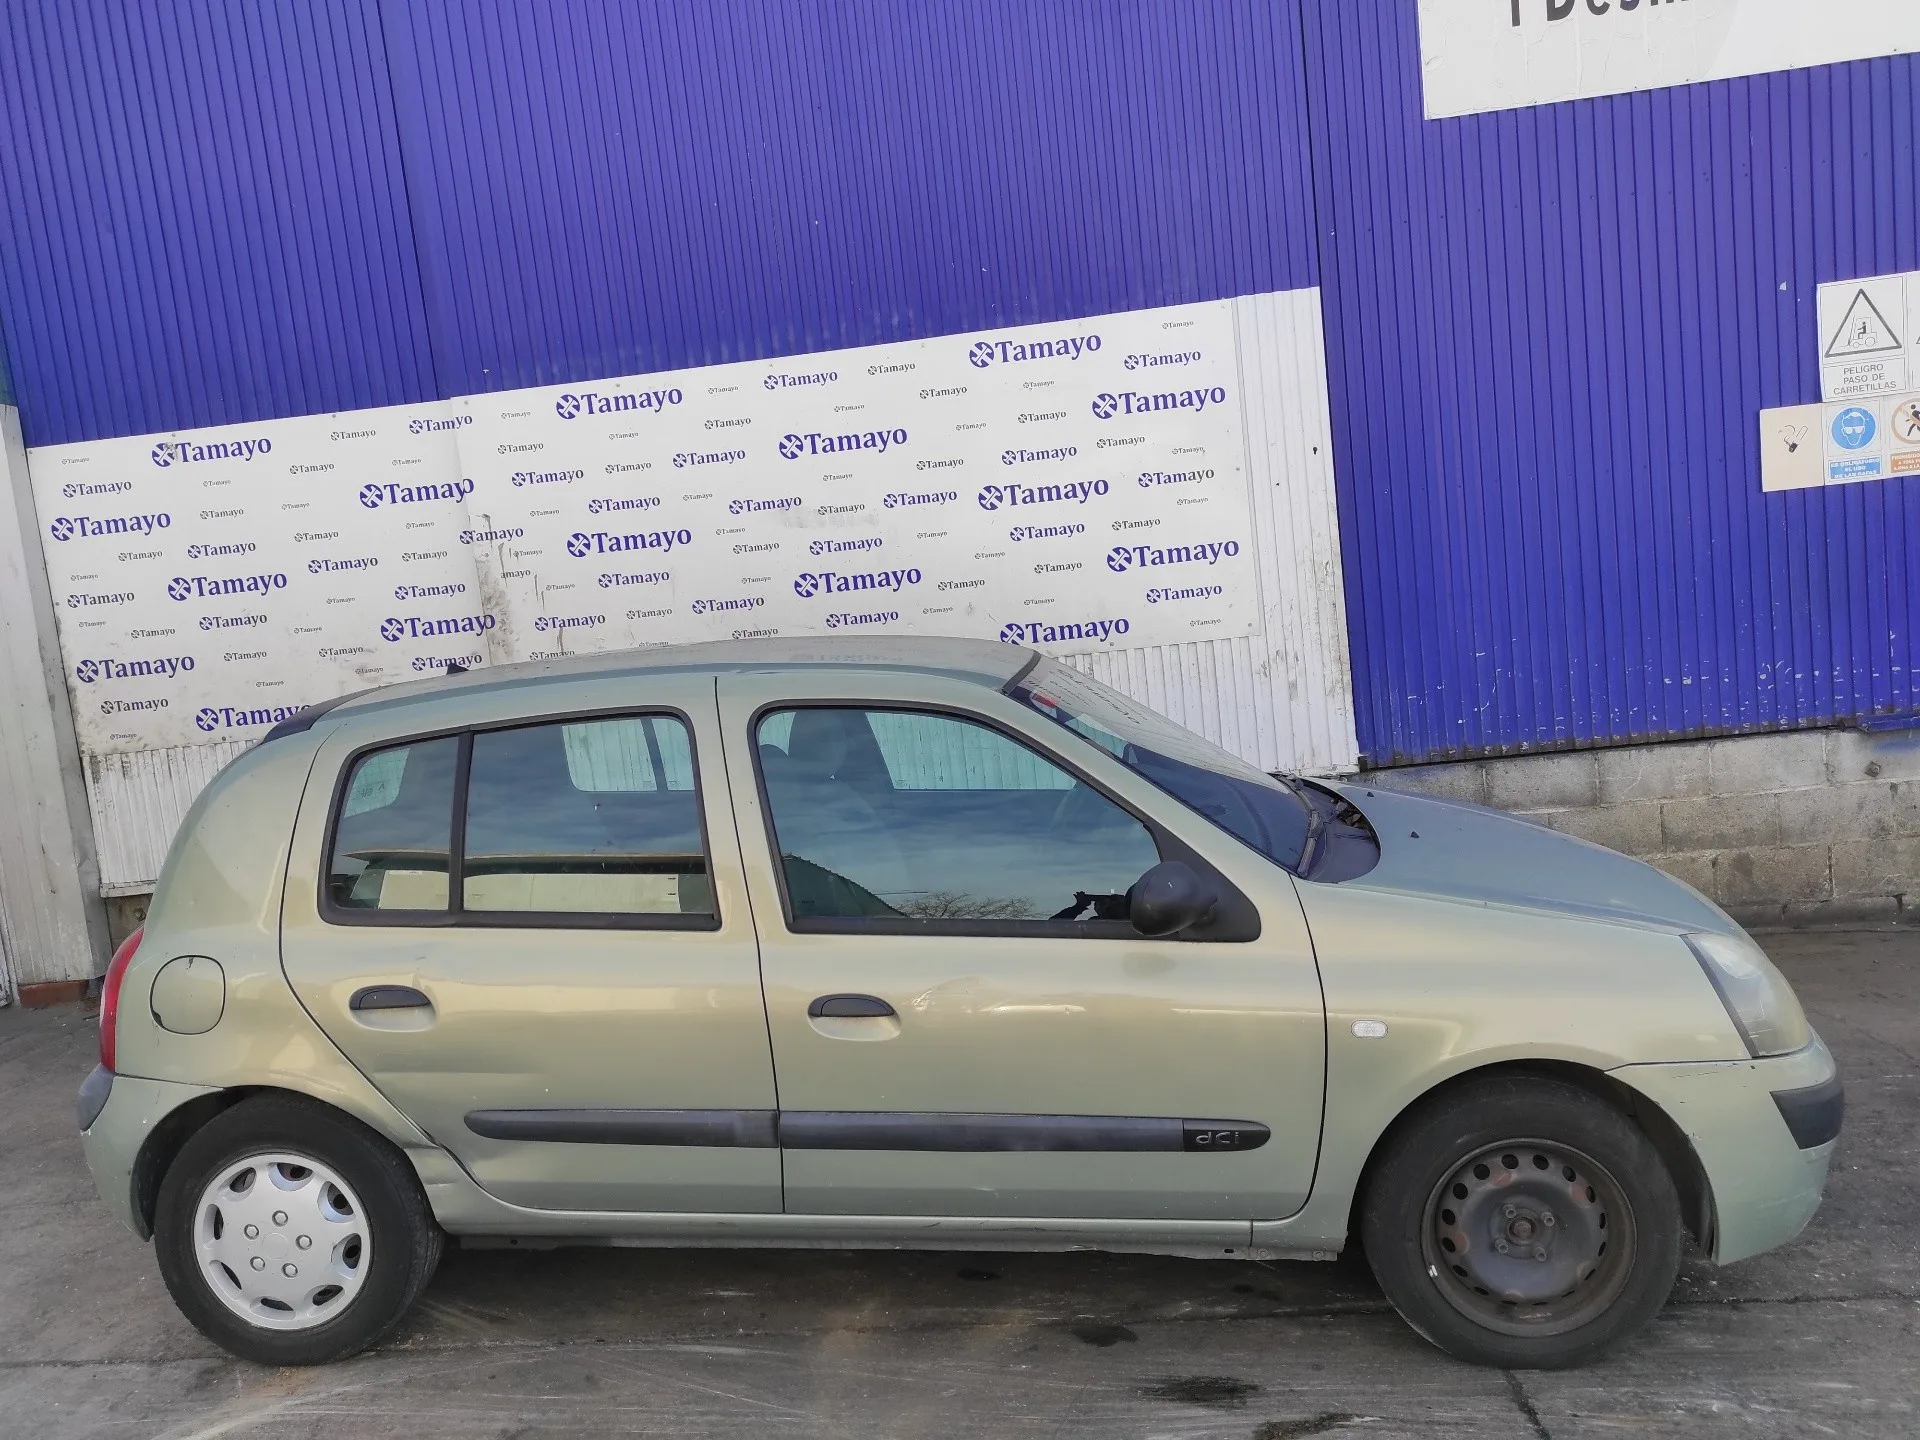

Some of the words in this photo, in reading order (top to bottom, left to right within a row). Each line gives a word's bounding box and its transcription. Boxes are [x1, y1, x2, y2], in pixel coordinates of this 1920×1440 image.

[995, 335, 1101, 363] Tamayo
[1141, 351, 1201, 367] Tamayo
[877, 364, 915, 373] Tamayo
[1843, 363, 1884, 375] PELIGRO
[778, 372, 837, 387] Tamayo
[1843, 375, 1868, 385] PASO
[1872, 373, 1886, 381] DE
[930, 387, 967, 397] Tamayo
[1833, 381, 1897, 395] CARRETILLAS
[580, 389, 682, 414] Tamayo
[1117, 387, 1225, 414] Tamayo
[713, 418, 751, 428] Tamayo
[1027, 412, 1066, 421] Tamayo
[339, 430, 376, 439] Tamayo
[507, 443, 543, 452] Tamayo
[803, 429, 907, 455] Tamayo
[1107, 437, 1145, 447] Tamayo
[175, 439, 271, 463] Tamayo
[688, 450, 745, 465] Tamayo
[1016, 447, 1077, 462] Tamayo
[298, 464, 334, 473] Tamayo
[615, 463, 651, 472] Tamayo
[925, 459, 963, 468] Tamayo
[526, 470, 584, 484] Tamayo
[1154, 469, 1214, 485] Tamayo
[76, 481, 131, 495] Tamayo
[383, 479, 474, 504] Tamayo
[1004, 480, 1109, 506] Tamayo
[602, 497, 660, 511] Tamayo
[744, 497, 802, 512] Tamayo
[897, 491, 957, 507] Tamayo
[210, 509, 243, 518] Tamayo
[826, 504, 865, 514] Tamayo
[74, 513, 170, 537] Tamayo
[1122, 519, 1160, 529] Tamayo
[304, 532, 338, 540] Tamayo
[1025, 524, 1085, 539] Tamayo
[590, 529, 691, 553] Tamayo
[743, 543, 779, 552] Tamayo
[824, 538, 882, 552] Tamayo
[128, 551, 162, 560] Tamayo
[201, 543, 256, 556] Tamayo
[412, 551, 447, 560] Tamayo
[1133, 541, 1239, 567] Tamayo
[324, 558, 378, 573] Tamayo
[1044, 563, 1082, 572] Tamayo
[192, 574, 287, 597] Tamayo
[614, 572, 669, 585] Tamayo
[819, 569, 921, 593] Tamayo
[947, 580, 985, 589] Tamayo
[408, 584, 465, 597] Tamayo
[1160, 586, 1222, 601] Tamayo
[80, 591, 135, 606] Tamayo
[707, 594, 764, 611] Tamayo
[635, 609, 672, 618] Tamayo
[843, 610, 898, 625] Tamayo
[211, 614, 267, 628] Tamayo
[404, 614, 496, 638] Tamayo
[549, 614, 606, 630] Tamayo
[137, 629, 175, 637] Tamayo
[741, 628, 779, 638] Tamayo
[1025, 617, 1130, 644] Tamayo
[233, 652, 267, 660] Tamayo
[327, 645, 364, 656] Tamayo
[99, 655, 195, 679] Tamayo
[115, 699, 168, 712] Tamayo
[219, 704, 311, 728] Tamay
